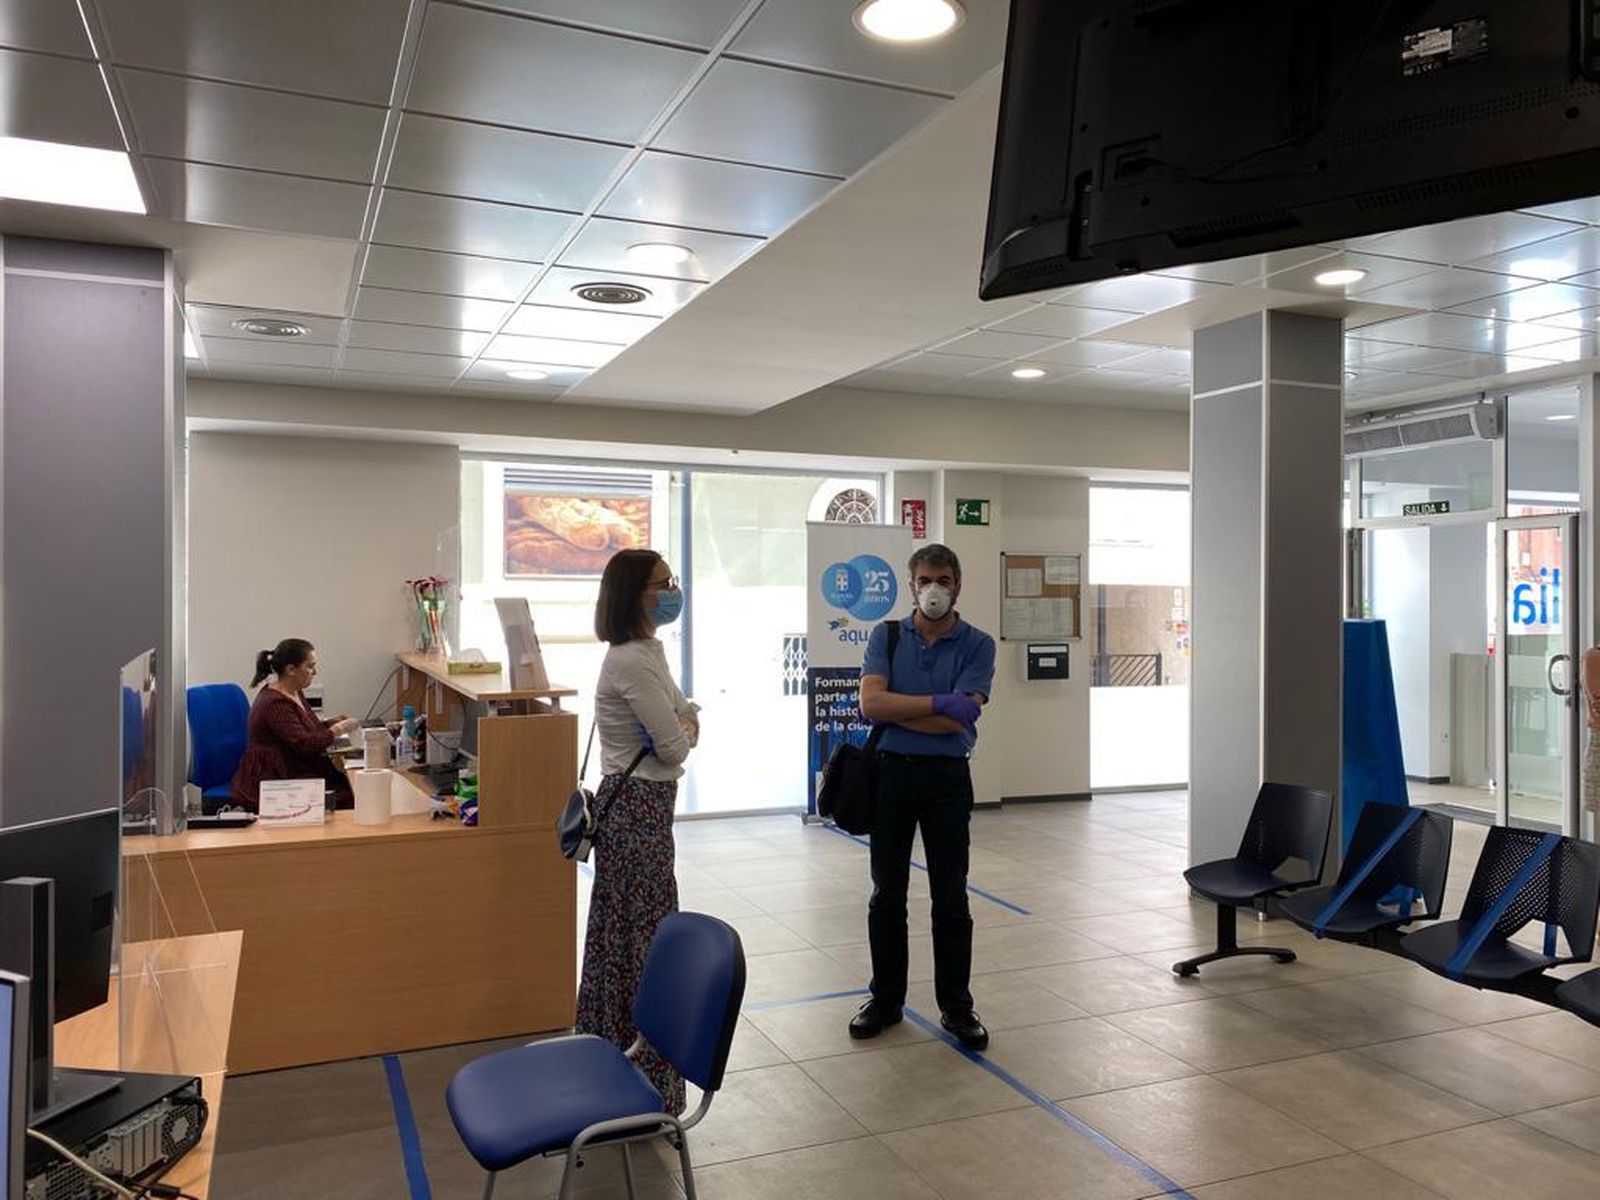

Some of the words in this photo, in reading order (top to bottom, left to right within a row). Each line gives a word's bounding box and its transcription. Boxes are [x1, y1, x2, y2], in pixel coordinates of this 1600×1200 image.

[1404, 503, 1437, 516] SALIDA
[864, 570, 890, 592] 25
[839, 629, 868, 645] aqu
[815, 677, 861, 688] Forman
[815, 692, 848, 704] parte
[850, 690, 860, 701] d
[815, 706, 826, 717] la
[829, 705, 859, 717] histo
[815, 721, 830, 732] de
[833, 721, 844, 732] la
[847, 721, 867, 732] ciu
